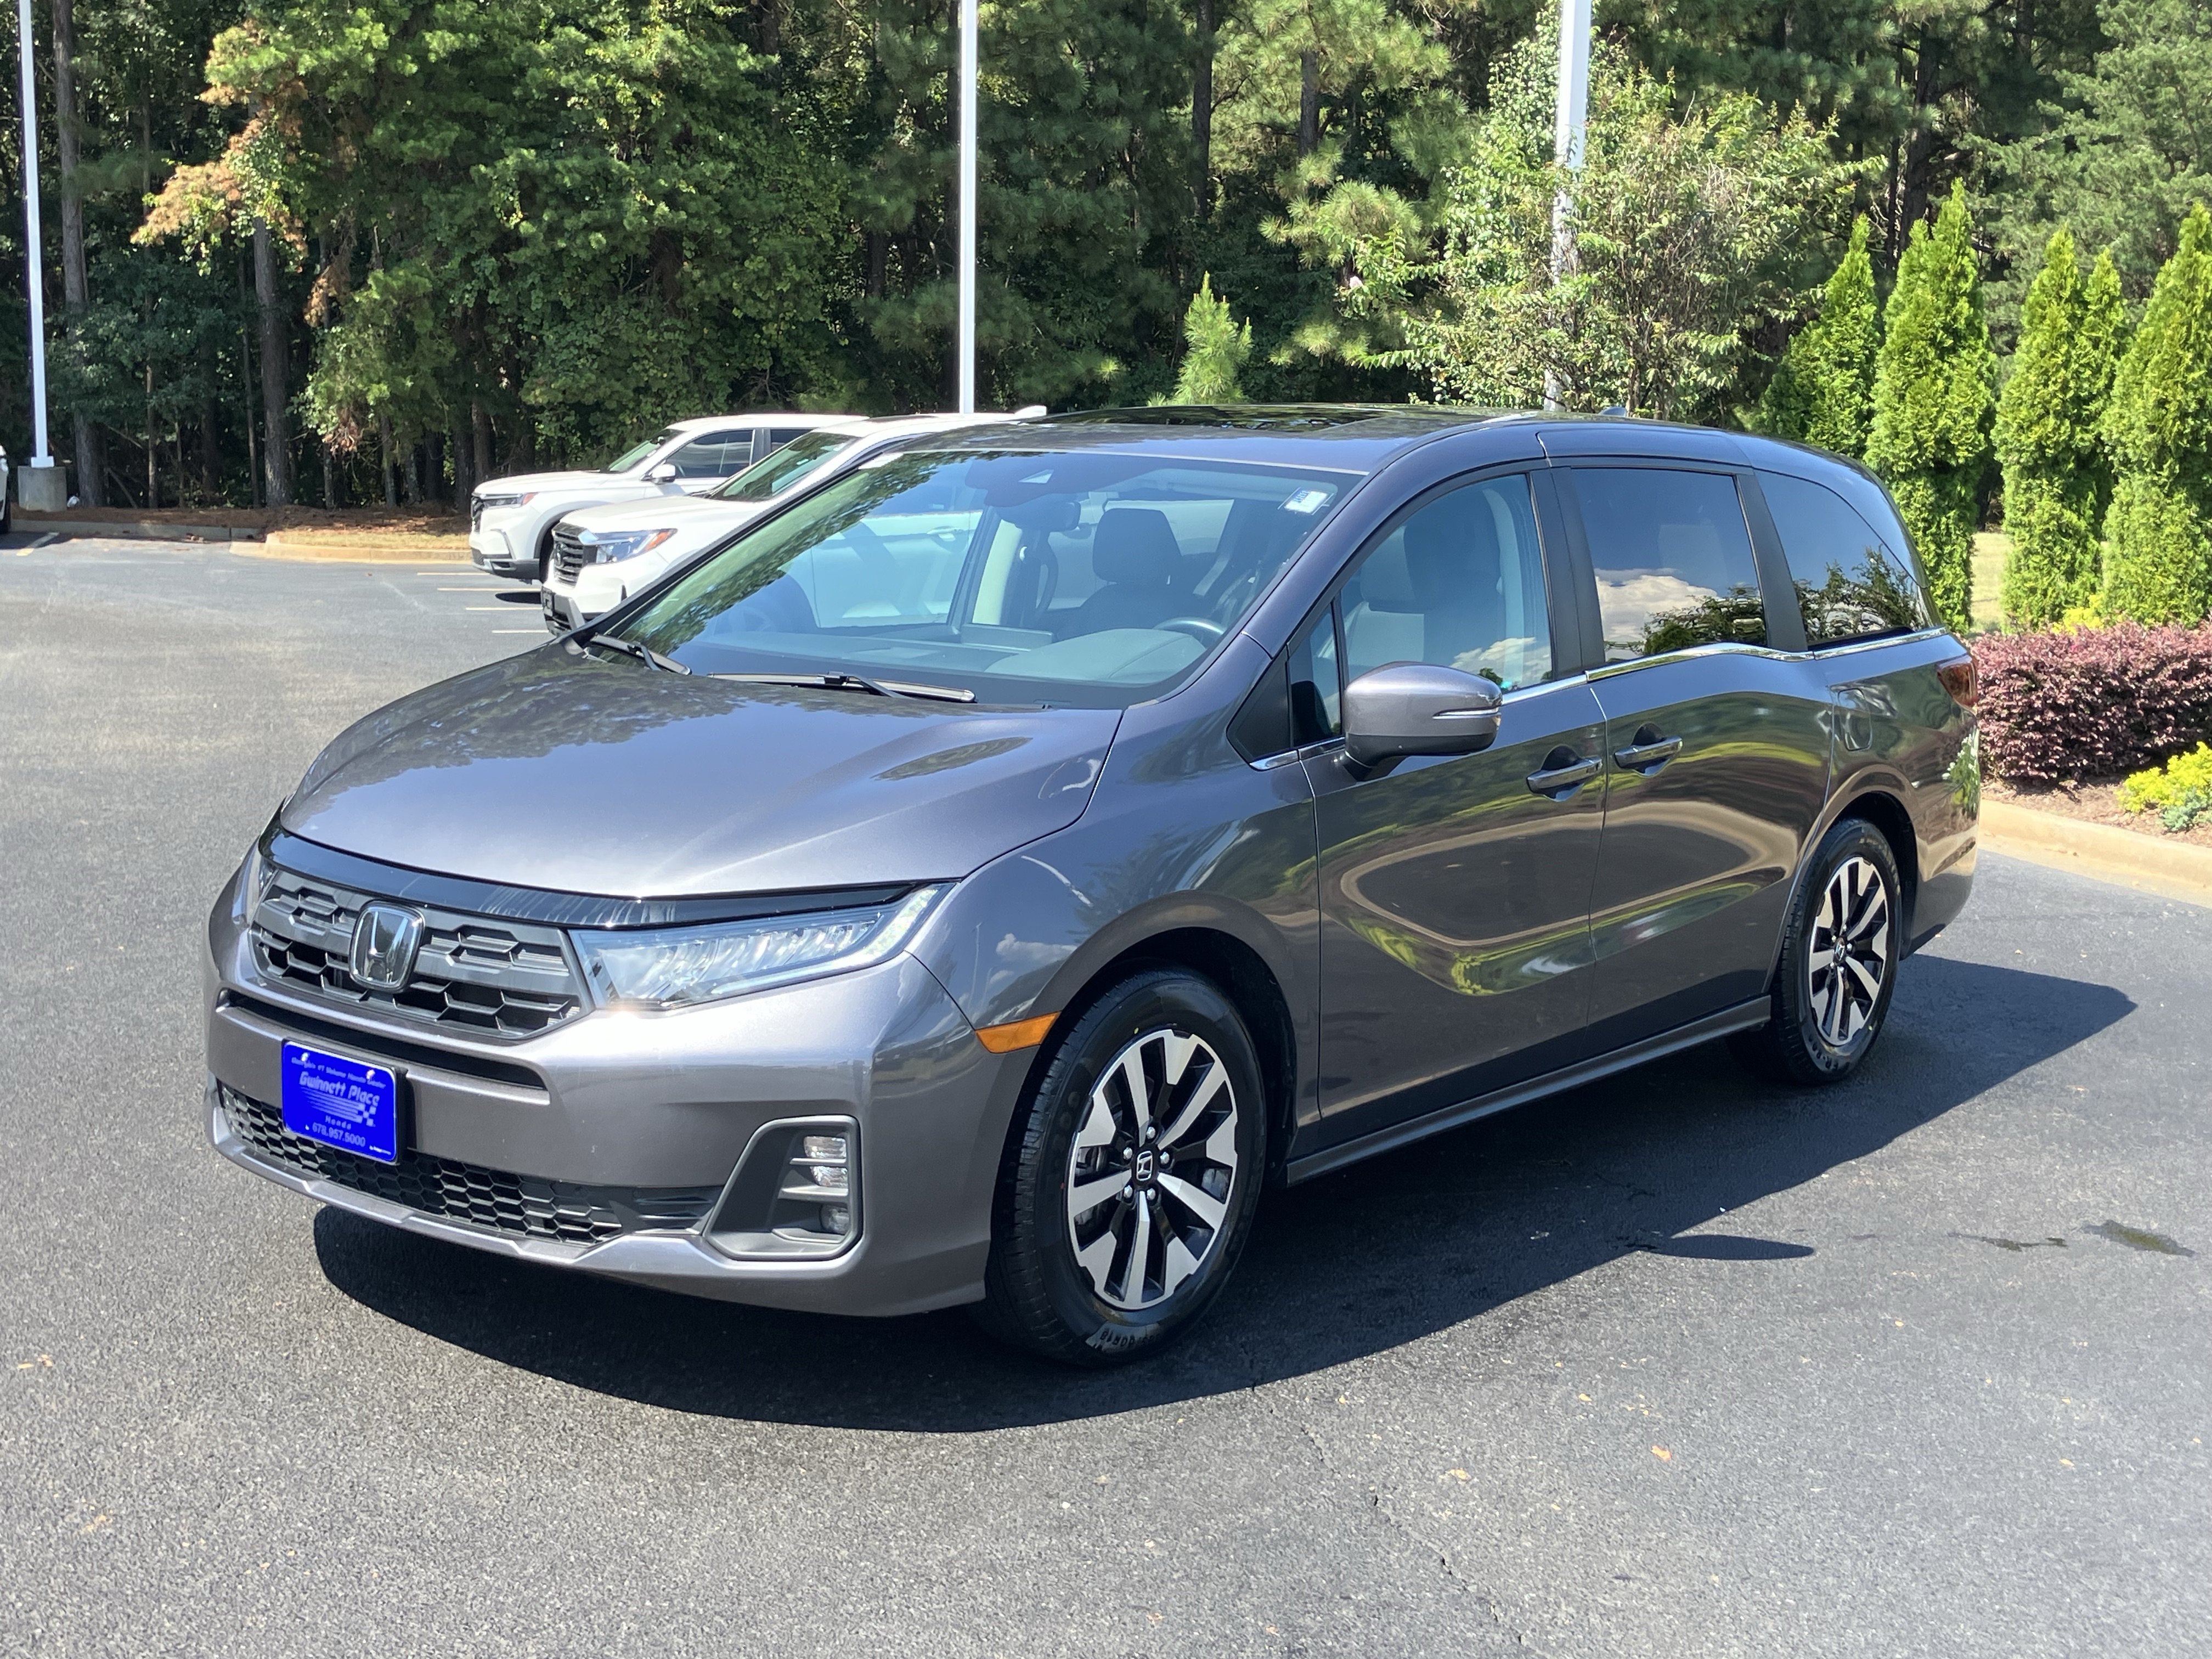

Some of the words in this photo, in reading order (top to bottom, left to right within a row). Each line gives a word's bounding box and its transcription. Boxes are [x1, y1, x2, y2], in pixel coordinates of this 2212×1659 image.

[299, 1071, 346, 1097] Gwinnett
[348, 1085, 380, 1107] Place
[312, 1122, 366, 1147] 678.957.5000
